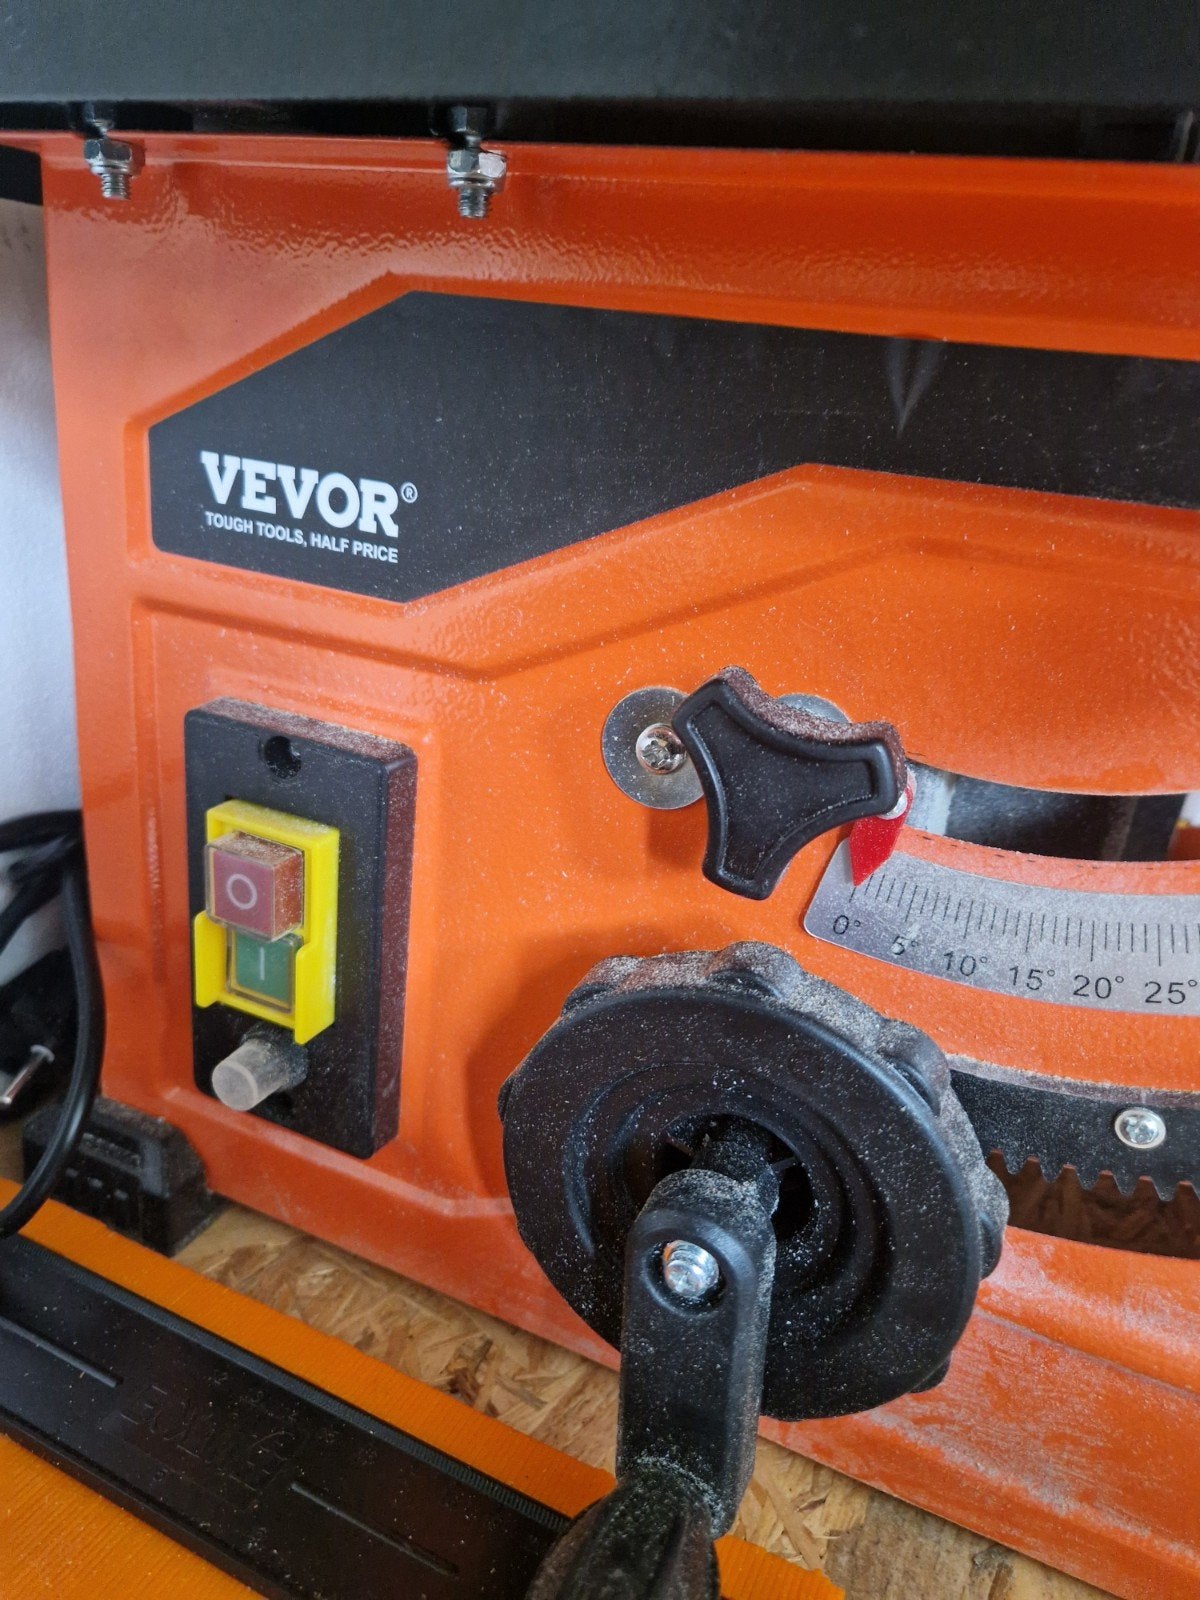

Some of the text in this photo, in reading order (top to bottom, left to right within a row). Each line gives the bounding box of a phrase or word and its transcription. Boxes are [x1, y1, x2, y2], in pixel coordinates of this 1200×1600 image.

[204, 510, 399, 564] TOUGH TOOLS, HALF PRICE
[944, 950, 988, 977] 10°
[1009, 966, 1056, 991] 15°
[1073, 974, 1125, 999] 20°
[1144, 979, 1198, 1005] 25°
